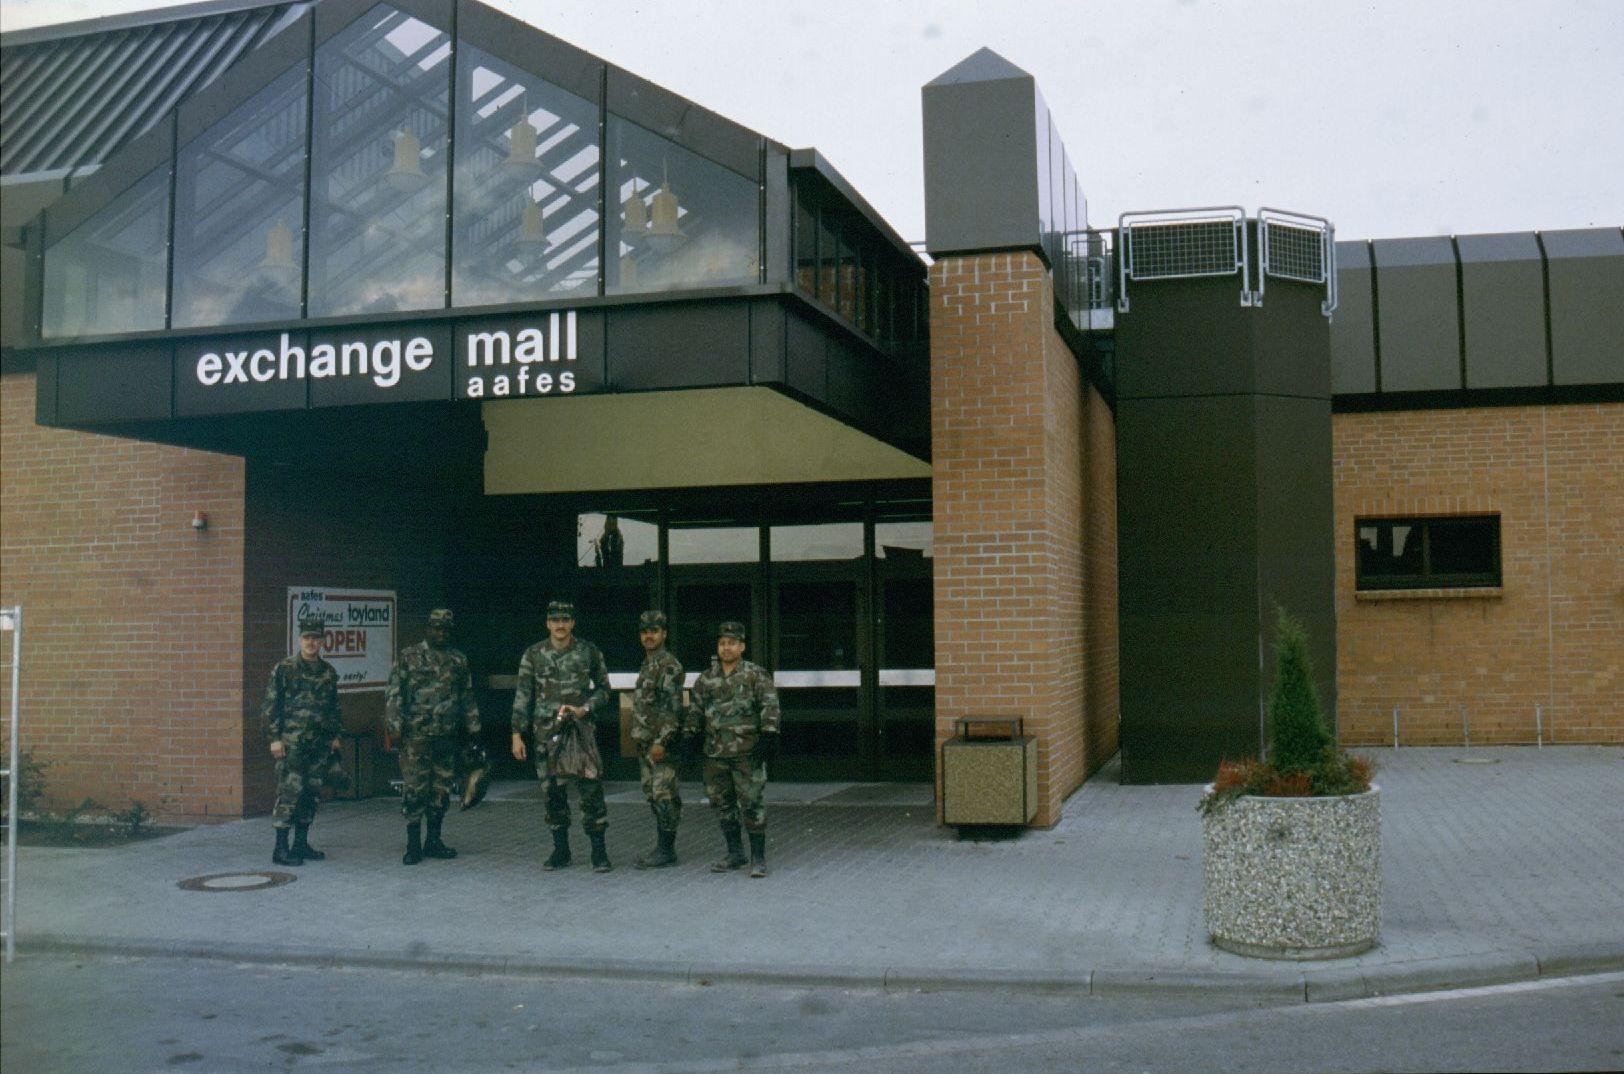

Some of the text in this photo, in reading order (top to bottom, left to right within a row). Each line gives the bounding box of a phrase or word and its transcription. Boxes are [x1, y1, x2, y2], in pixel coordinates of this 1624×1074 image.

[196, 311, 577, 387] exchange mall
[467, 366, 576, 397] aafes
[348, 604, 389, 624] toyland
[324, 630, 366, 652] OPEN
